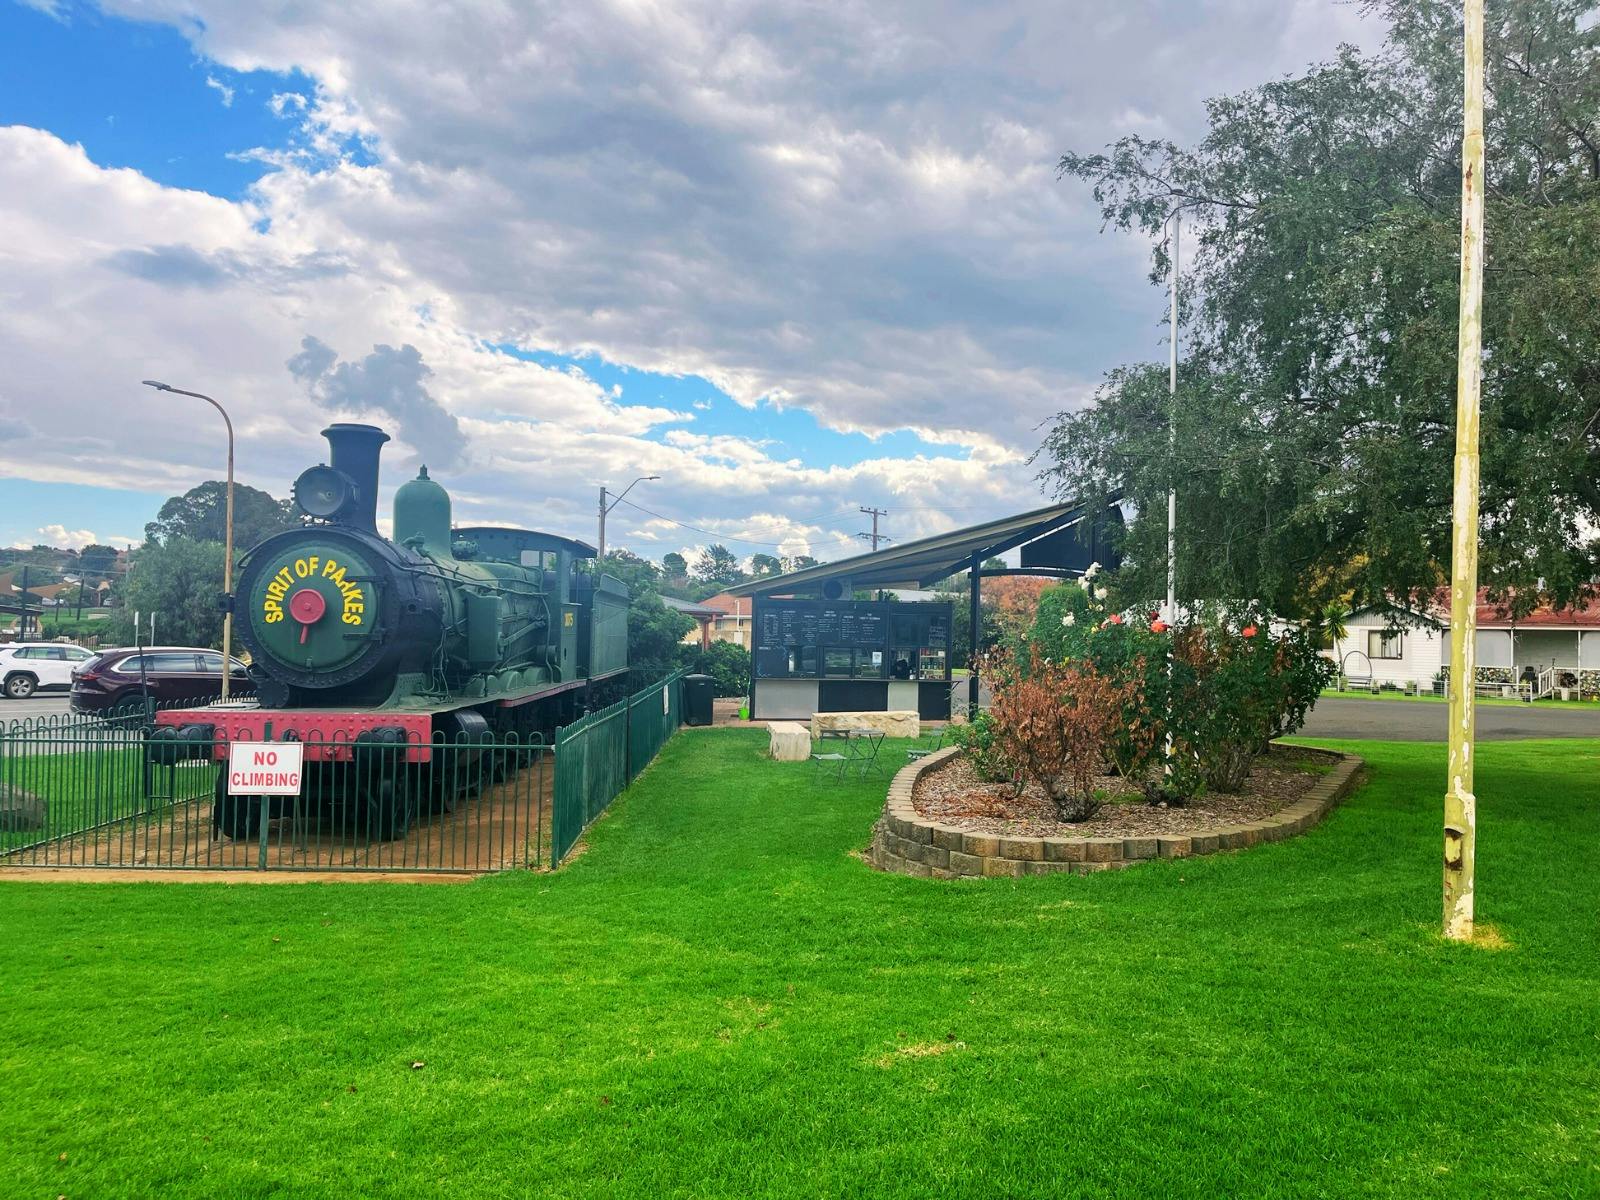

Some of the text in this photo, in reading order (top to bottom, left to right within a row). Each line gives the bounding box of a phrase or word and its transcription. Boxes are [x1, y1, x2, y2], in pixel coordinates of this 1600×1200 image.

[264, 566, 295, 624] SPIRIT
[294, 556, 319, 578] OF
[254, 751, 278, 766] NO
[232, 772, 298, 787] CLIMBING
